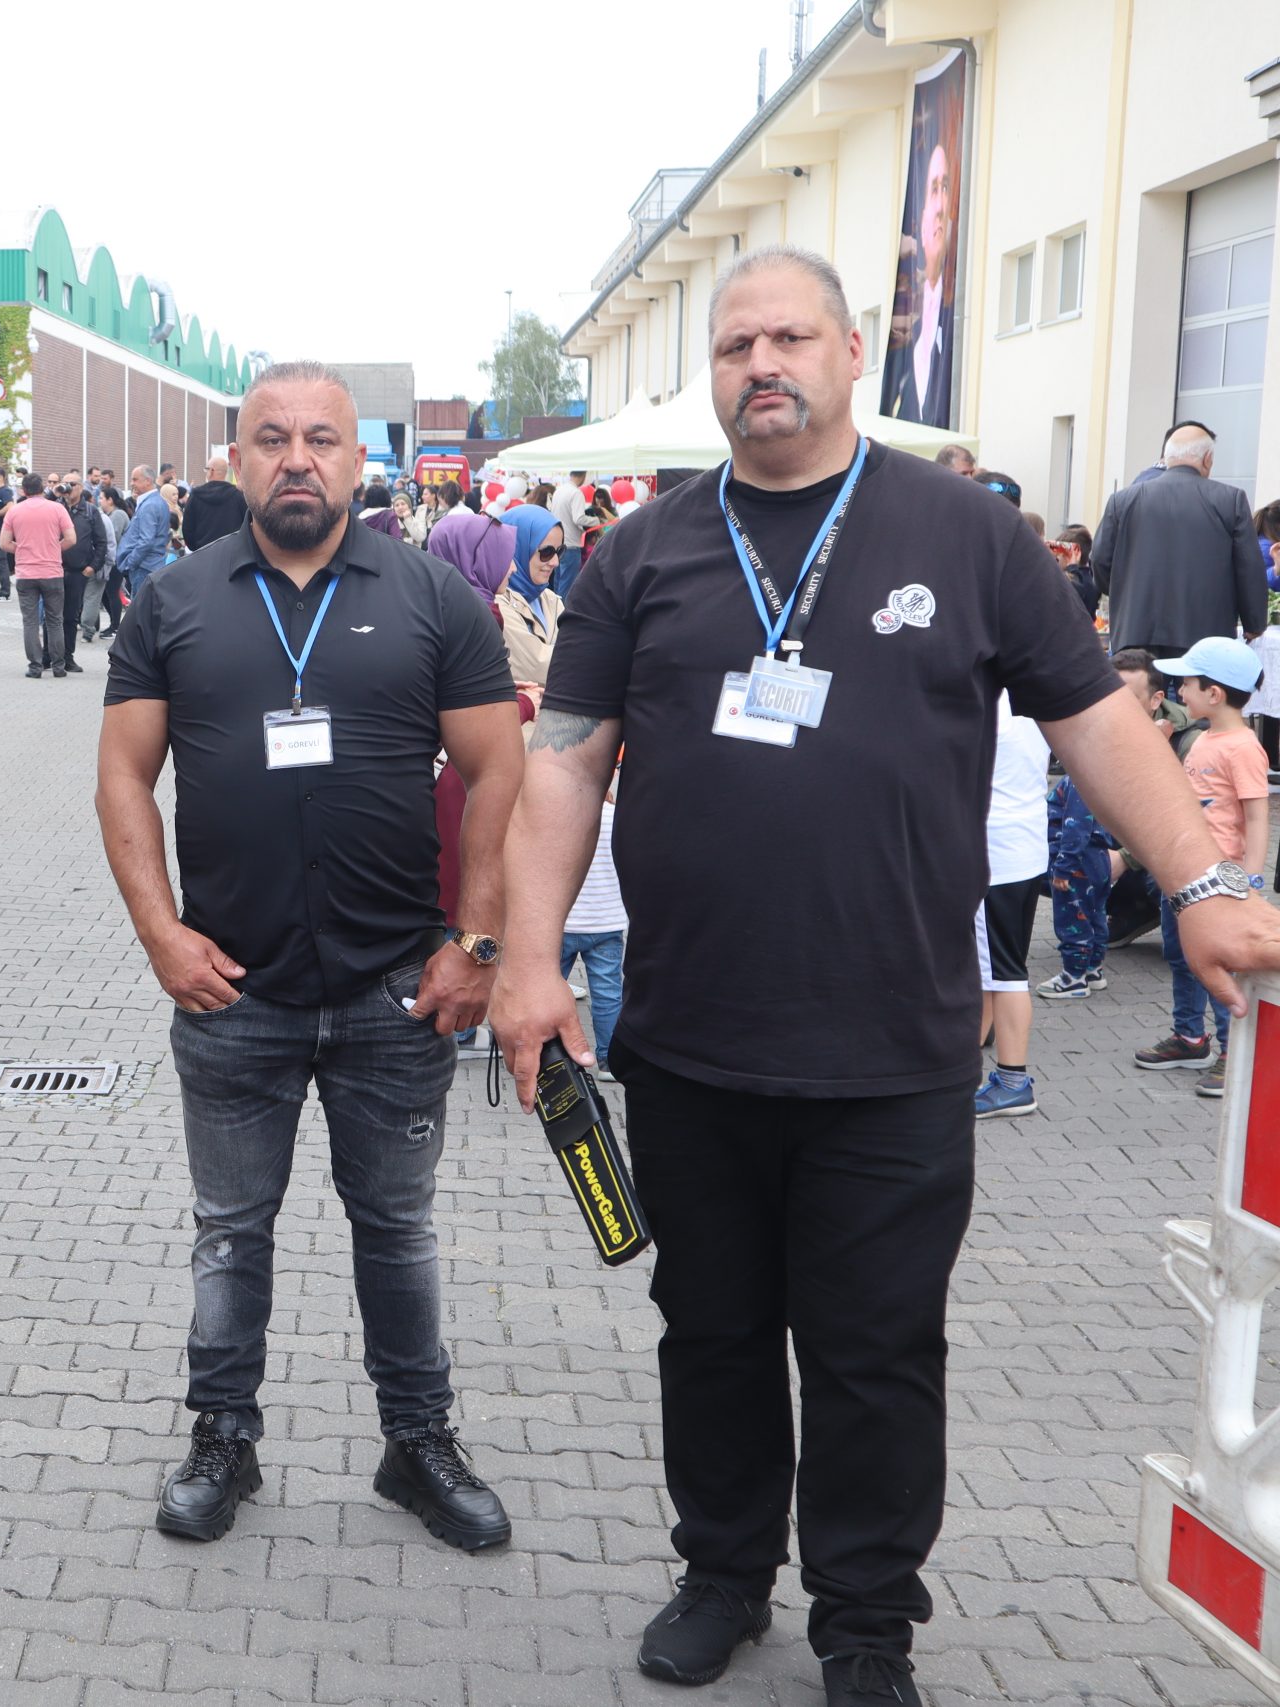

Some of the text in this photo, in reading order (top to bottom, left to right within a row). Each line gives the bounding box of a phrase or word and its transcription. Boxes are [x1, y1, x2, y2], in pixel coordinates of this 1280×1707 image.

[422, 470, 461, 486] LEX
[740, 533, 764, 570] SECURITY
[818, 524, 839, 565] SECURITY
[761, 577, 784, 614] SECURIT
[800, 571, 822, 615] SECURITY
[748, 679, 817, 720] SECURITY
[575, 1143, 622, 1244] PowerGate
